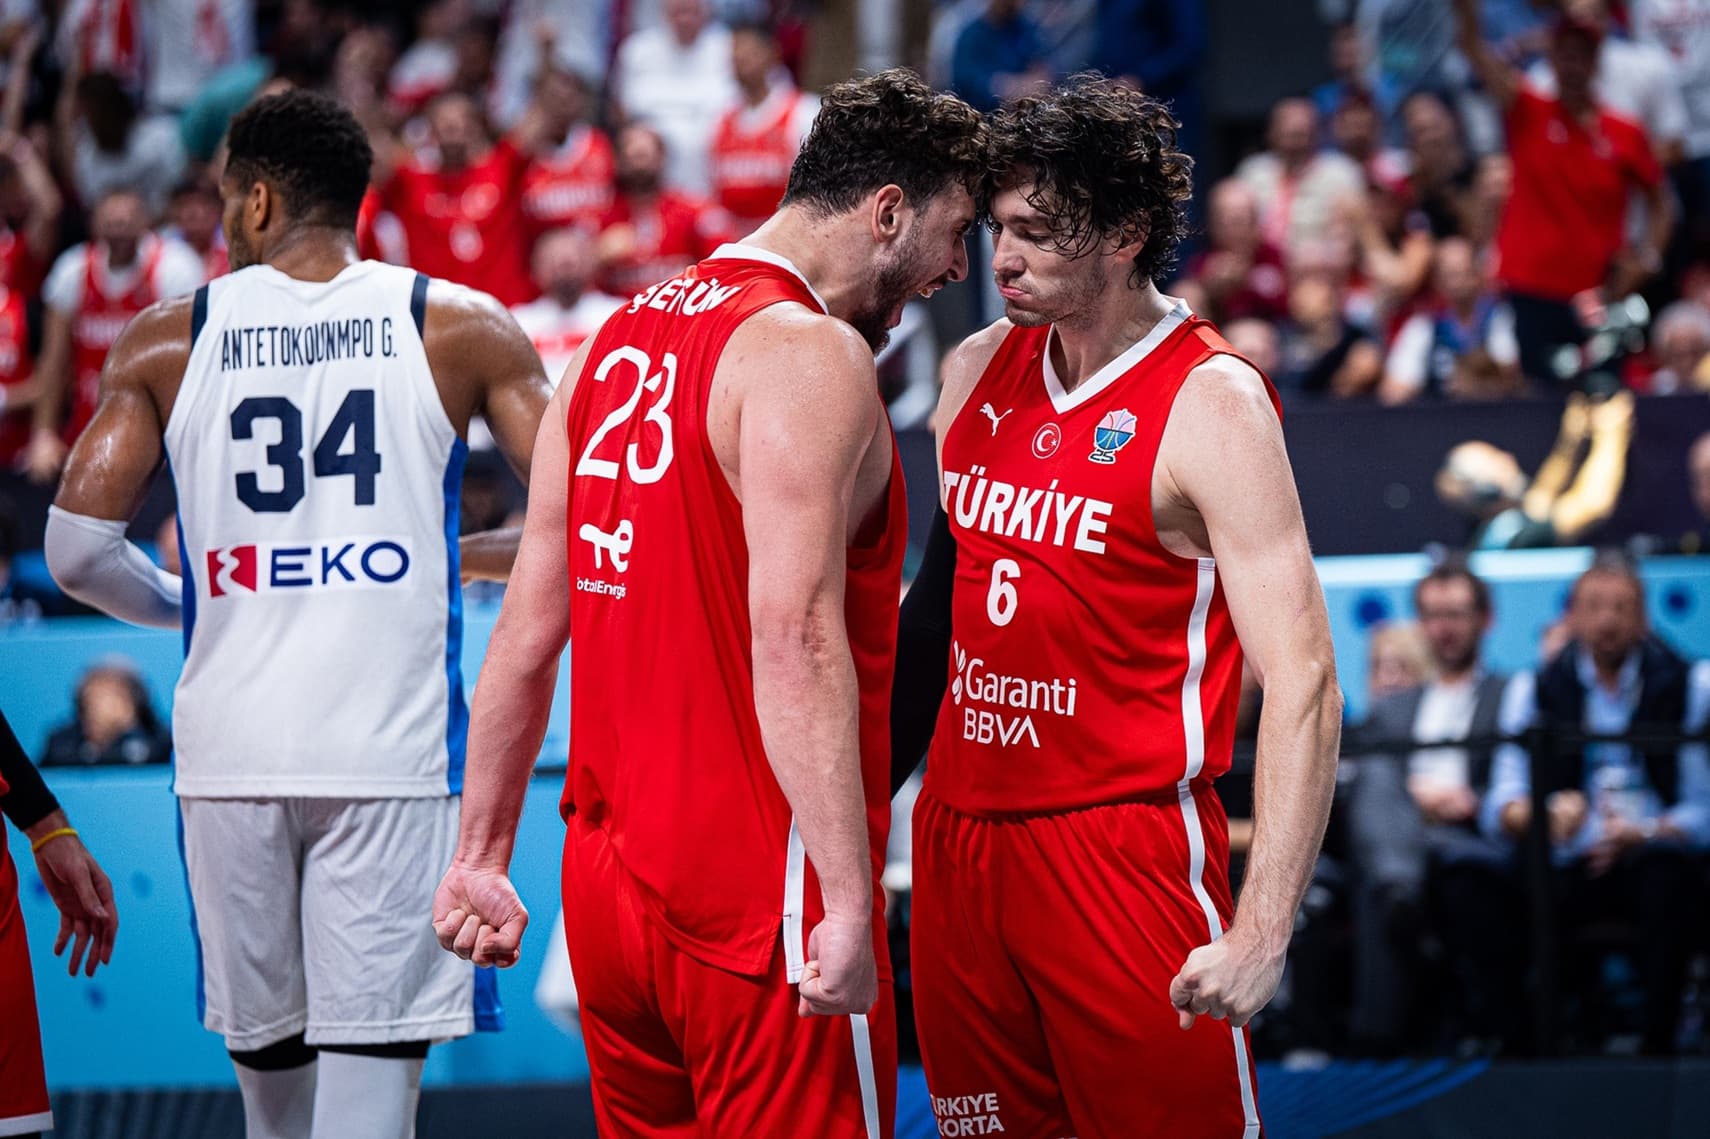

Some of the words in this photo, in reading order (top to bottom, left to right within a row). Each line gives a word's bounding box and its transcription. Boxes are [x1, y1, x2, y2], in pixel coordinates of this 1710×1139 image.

[221, 318, 373, 372] ANTETOKOUNMPO
[382, 316, 398, 358] G.
[575, 346, 678, 485] 23
[230, 389, 382, 513] 34
[943, 464, 1113, 555] TÜRKİYE
[270, 541, 411, 587] EKO
[986, 558, 1021, 627] 6
[966, 657, 1077, 717] Garanti
[963, 707, 1040, 748] BBVA
[930, 1092, 1000, 1116] RKİYE
